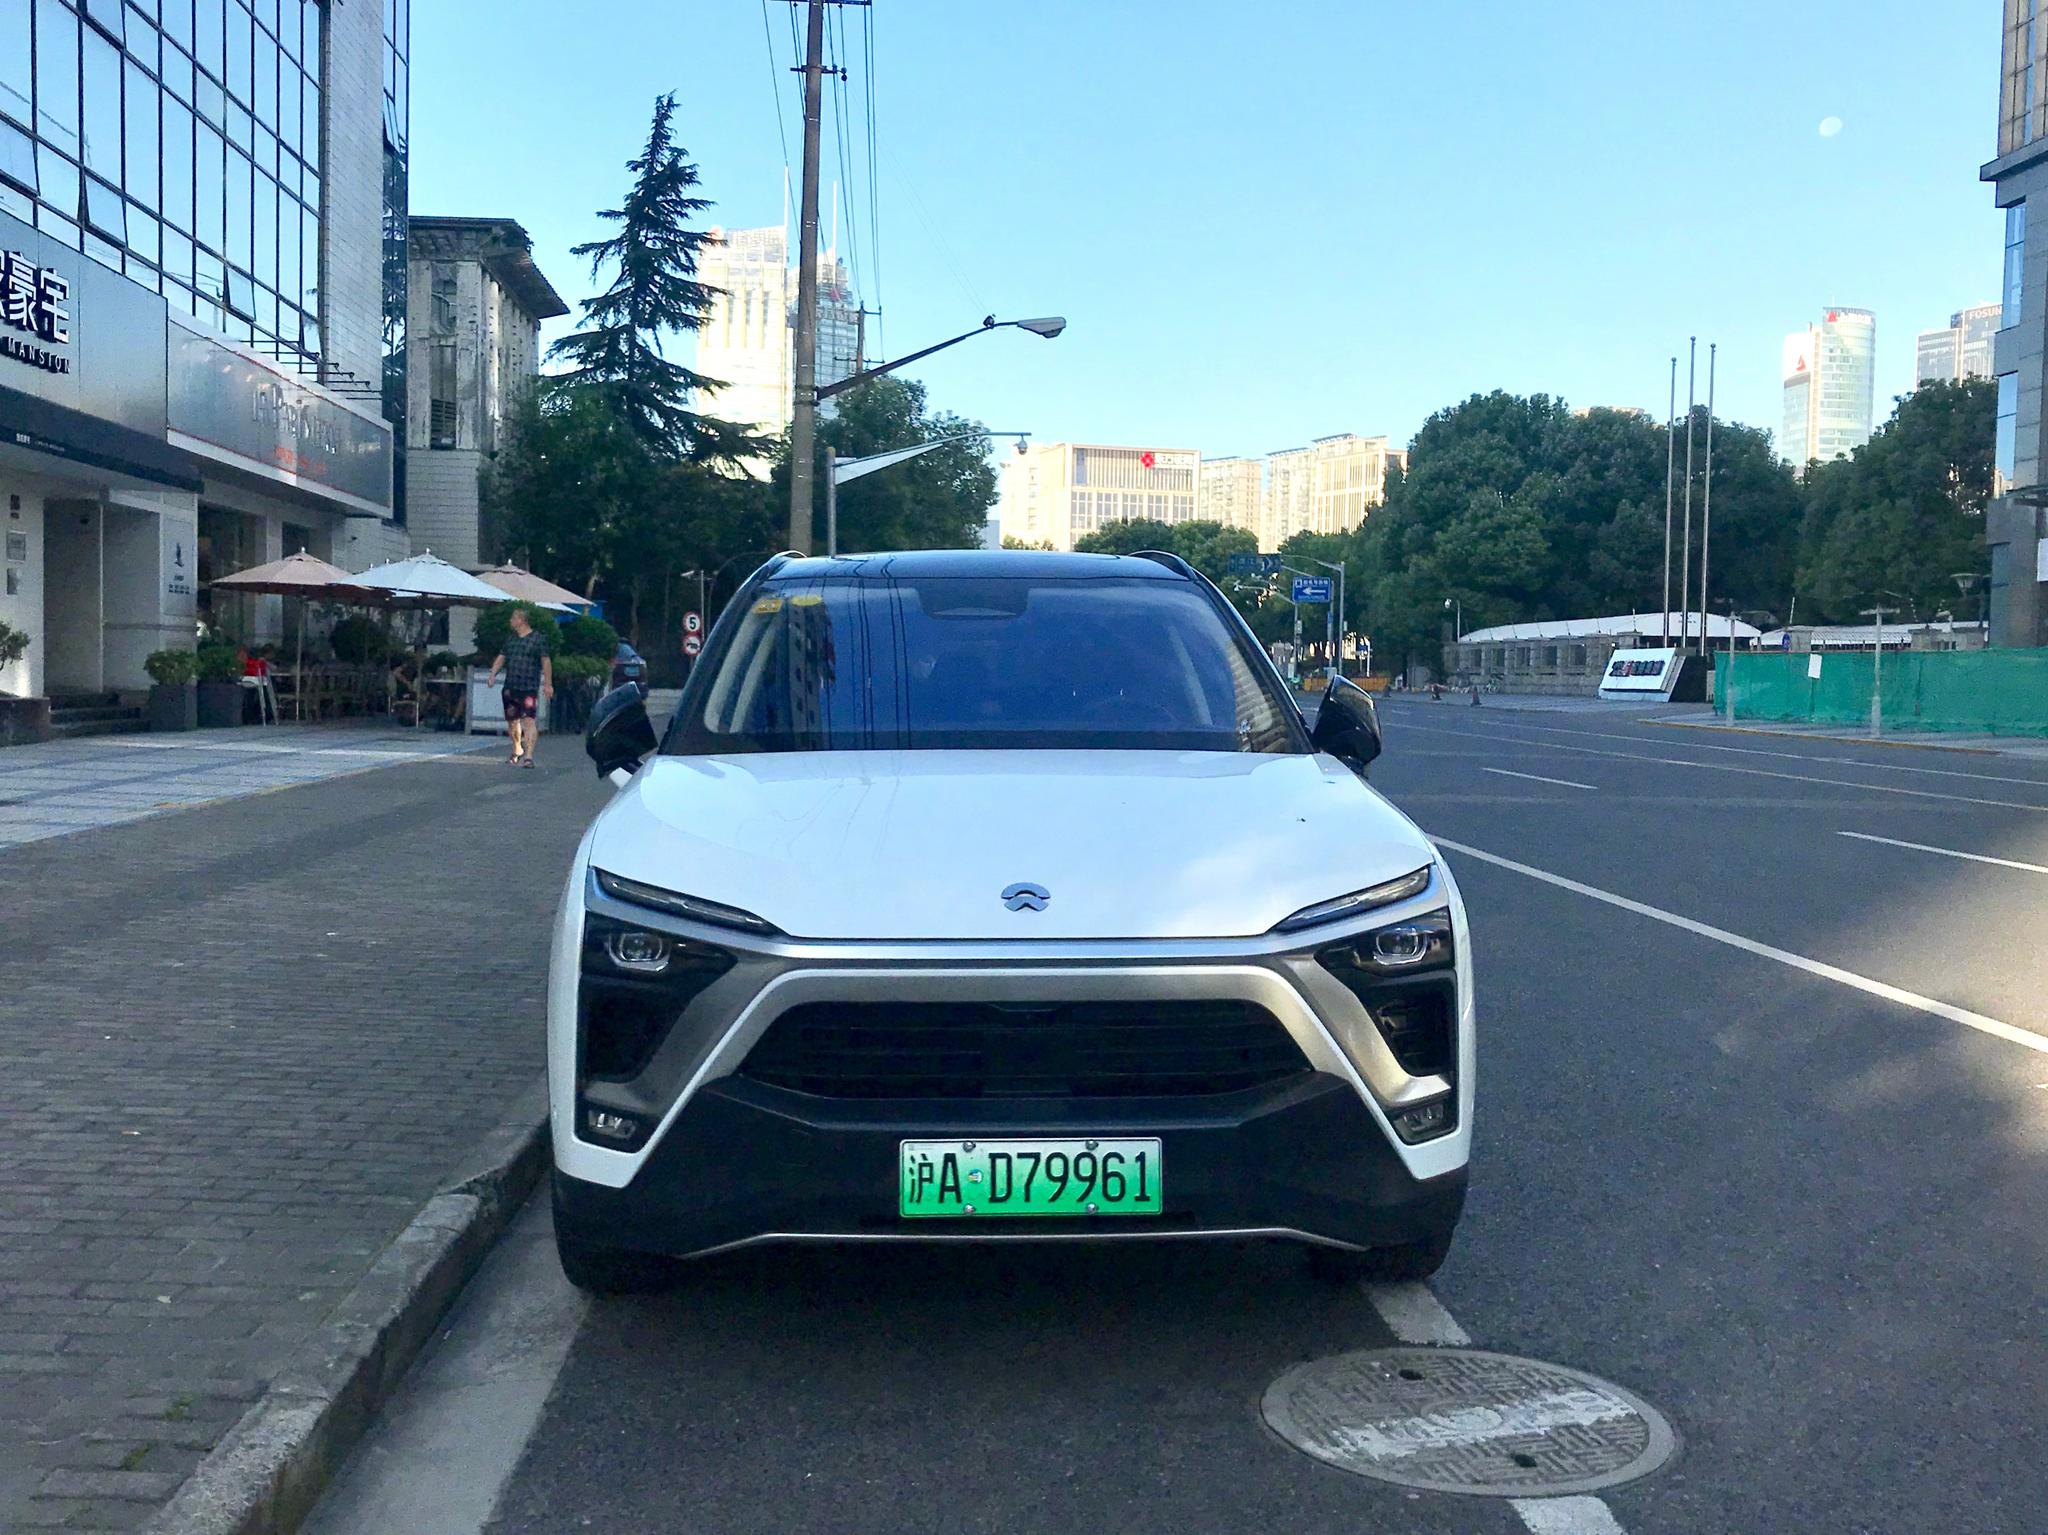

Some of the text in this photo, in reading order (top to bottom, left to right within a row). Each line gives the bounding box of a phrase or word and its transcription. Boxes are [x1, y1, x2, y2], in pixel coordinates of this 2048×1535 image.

[0, 250, 69, 344] 豪宅
[1969, 304, 2001, 320] FOSUN
[8, 337, 70, 374] MANSION
[689, 616, 697, 630] 5
[909, 1151, 1151, 1204] 沪A D79961
